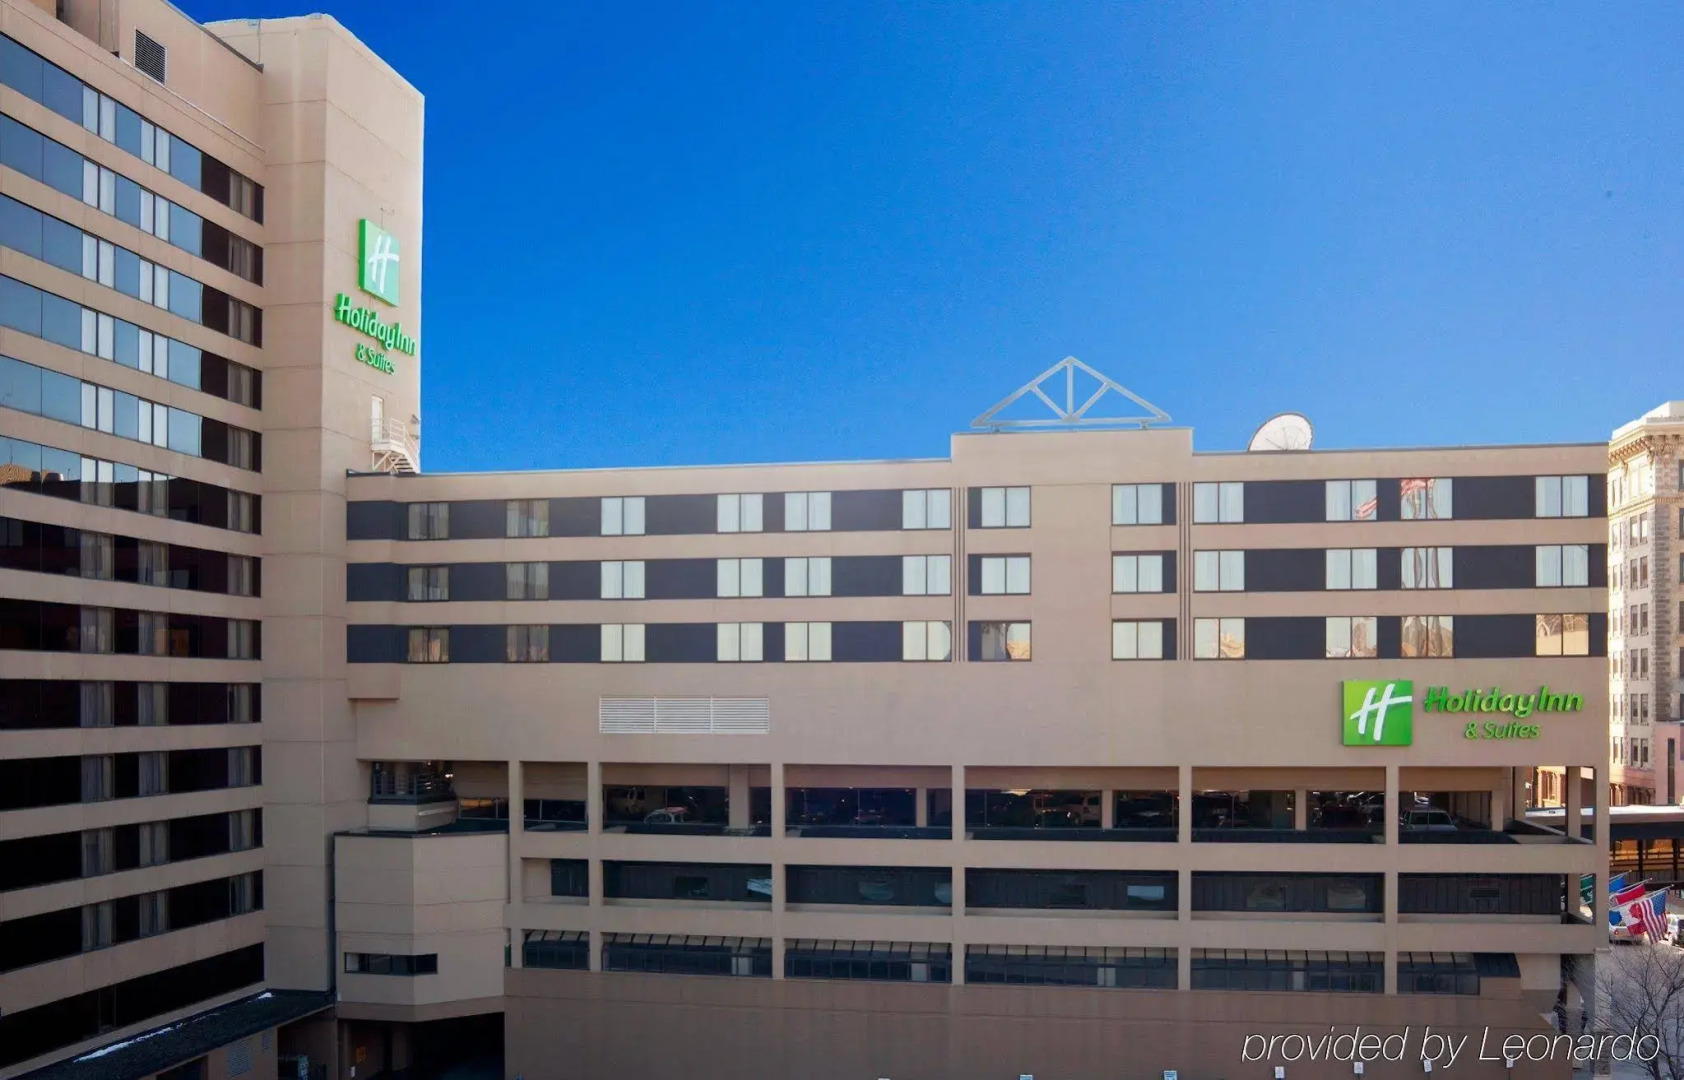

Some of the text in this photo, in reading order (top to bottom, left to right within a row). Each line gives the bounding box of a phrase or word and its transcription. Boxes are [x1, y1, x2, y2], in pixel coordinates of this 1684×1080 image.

[334, 293, 416, 356] Holiday Inn
[355, 341, 396, 375] & Suites
[1350, 683, 1412, 741] H
[1424, 685, 1584, 718] Holiday Inn
[1464, 720, 1540, 740] & Suites
